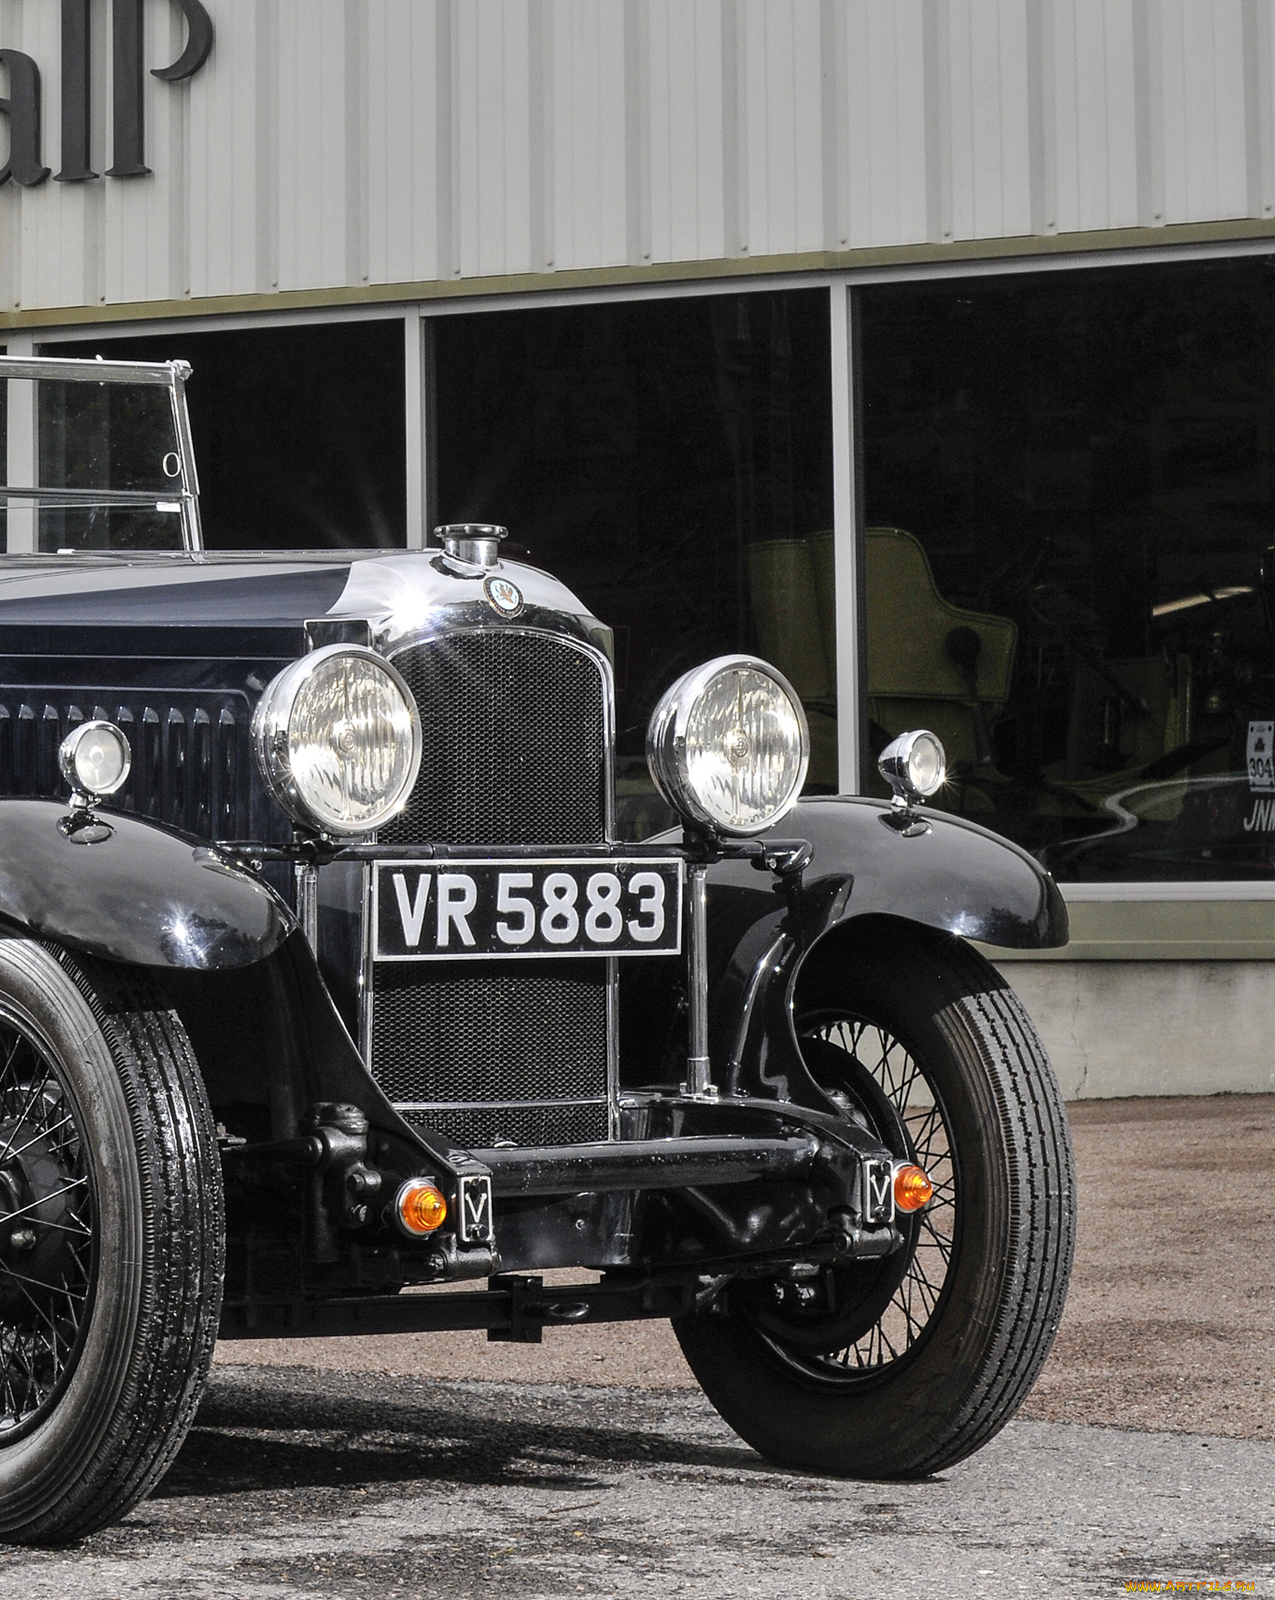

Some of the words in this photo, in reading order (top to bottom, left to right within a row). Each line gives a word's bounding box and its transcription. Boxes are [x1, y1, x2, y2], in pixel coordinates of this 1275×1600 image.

[1249, 757, 1273, 778] 304
[392, 873, 477, 947] VR
[496, 872, 665, 945] 5883
